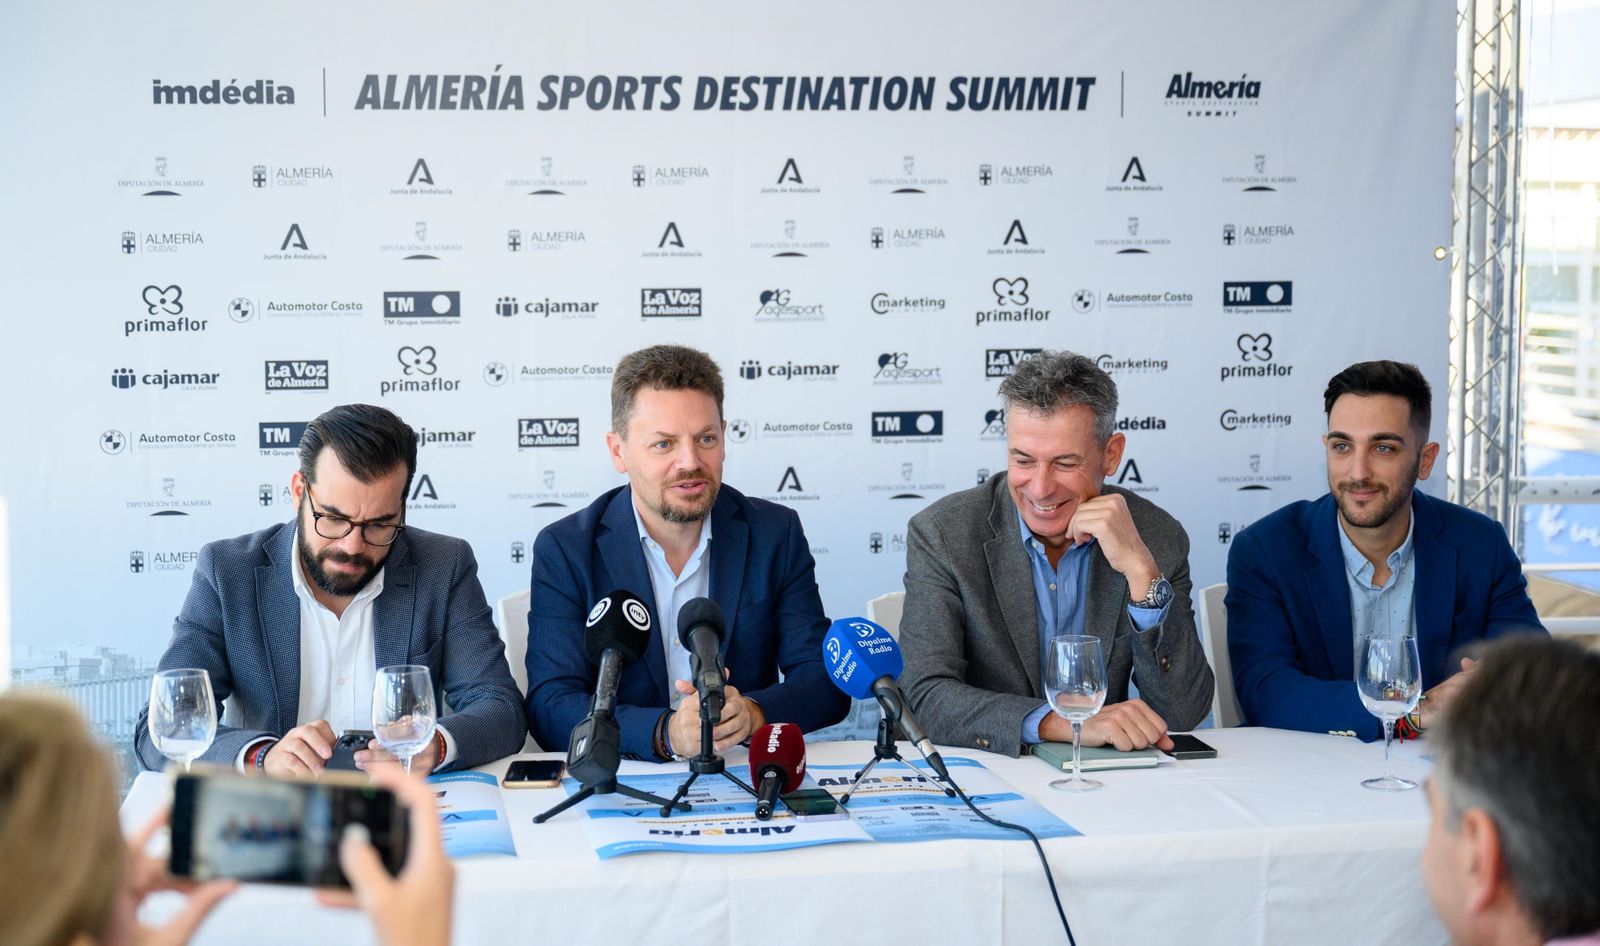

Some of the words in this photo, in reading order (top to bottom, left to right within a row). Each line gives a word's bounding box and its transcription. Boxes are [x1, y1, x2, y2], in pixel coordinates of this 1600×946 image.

[152, 78, 295, 105] imdédia
[354, 64, 524, 111] ALMERÍA
[537, 74, 683, 111] SPORTS
[693, 76, 936, 111] DESTINATION
[946, 76, 1097, 111] SUMMIT
[1165, 71, 1261, 99] Almería
[276, 166, 334, 179] ALMERÍA
[654, 165, 709, 178] ALMERÍA
[1000, 164, 1053, 177] ALMERÍA
[164, 180, 172, 188] DE
[145, 231, 204, 245] ALMERÍA
[531, 231, 586, 242] ALMERÍA
[893, 227, 946, 240] ALMERÍA
[1244, 224, 1295, 237] ALMERÍA
[643, 289, 664, 305] La
[667, 289, 700, 305] Voz
[1107, 293, 1162, 303] Automotor
[1164, 292, 1193, 302] Costa
[1226, 286, 1251, 302] TM
[267, 301, 328, 311] Automotor
[331, 300, 363, 311] Costa
[387, 297, 414, 313] TM
[524, 298, 599, 318] cajamar
[643, 305, 656, 315] de
[976, 308, 1051, 326] primaflor
[125, 317, 208, 337] primaflor
[988, 350, 1009, 365] La
[267, 361, 290, 378] La
[291, 361, 327, 378] Voz
[521, 365, 580, 375] Automotor
[582, 364, 613, 375] Costa
[767, 361, 840, 380] cajamar
[1221, 363, 1293, 382] primaflor
[142, 369, 220, 390] cajamar
[267, 378, 282, 389] de
[381, 377, 460, 397] primaflor
[520, 420, 543, 435] La
[544, 420, 577, 435] Voz
[763, 422, 820, 432] Automotor
[822, 421, 853, 431] Costa
[875, 416, 900, 432] TM
[139, 433, 201, 443] Automotor
[203, 432, 236, 442] Costa
[263, 427, 290, 443] TM
[417, 427, 476, 447] jamar
[520, 435, 534, 445] de
[154, 552, 198, 563] ALMER
[857, 636, 893, 648] Dipalme
[868, 645, 893, 655] Radio
[833, 649, 854, 679] Dipalme
[842, 661, 857, 683] Radio
